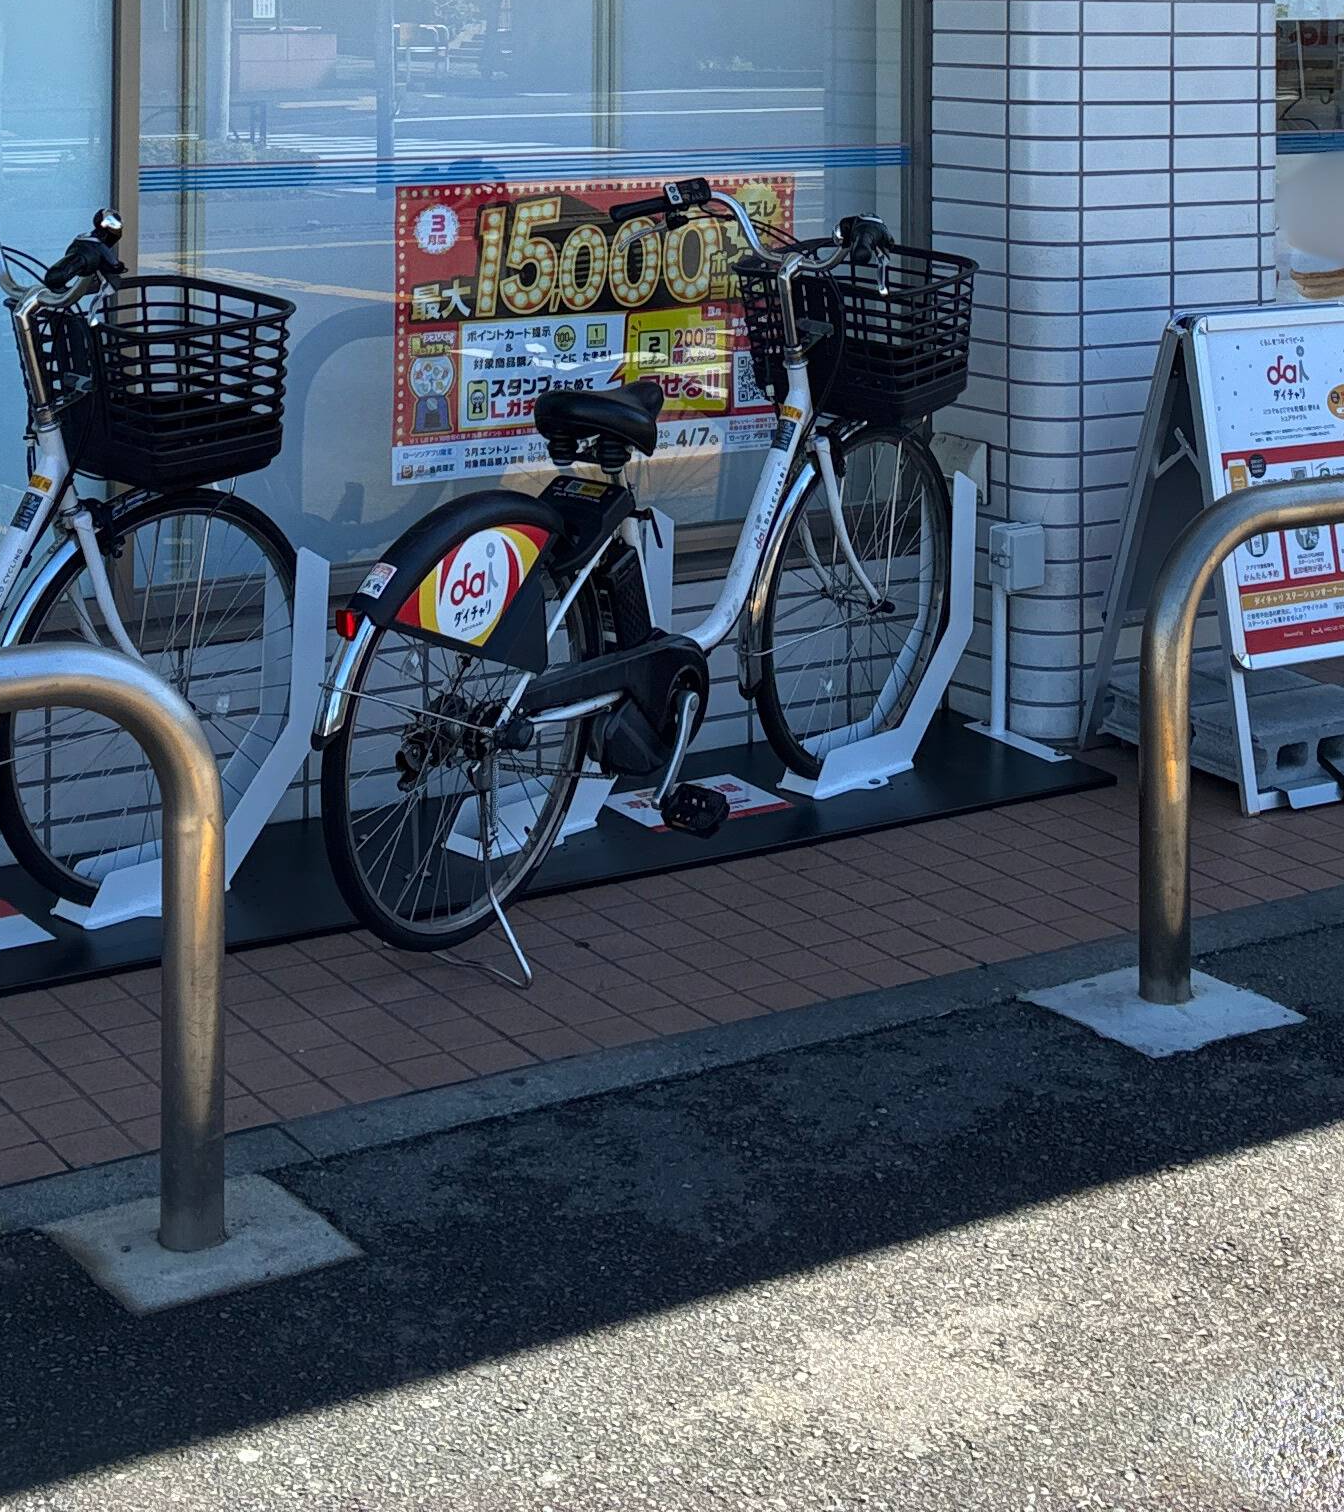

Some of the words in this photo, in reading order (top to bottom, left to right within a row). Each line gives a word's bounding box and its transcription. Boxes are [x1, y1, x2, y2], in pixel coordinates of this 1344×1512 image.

[412, 279, 472, 320] 最大
[1267, 345, 1310, 386] dai
[450, 542, 499, 606] dai
[453, 598, 492, 628] ダイチャリ
